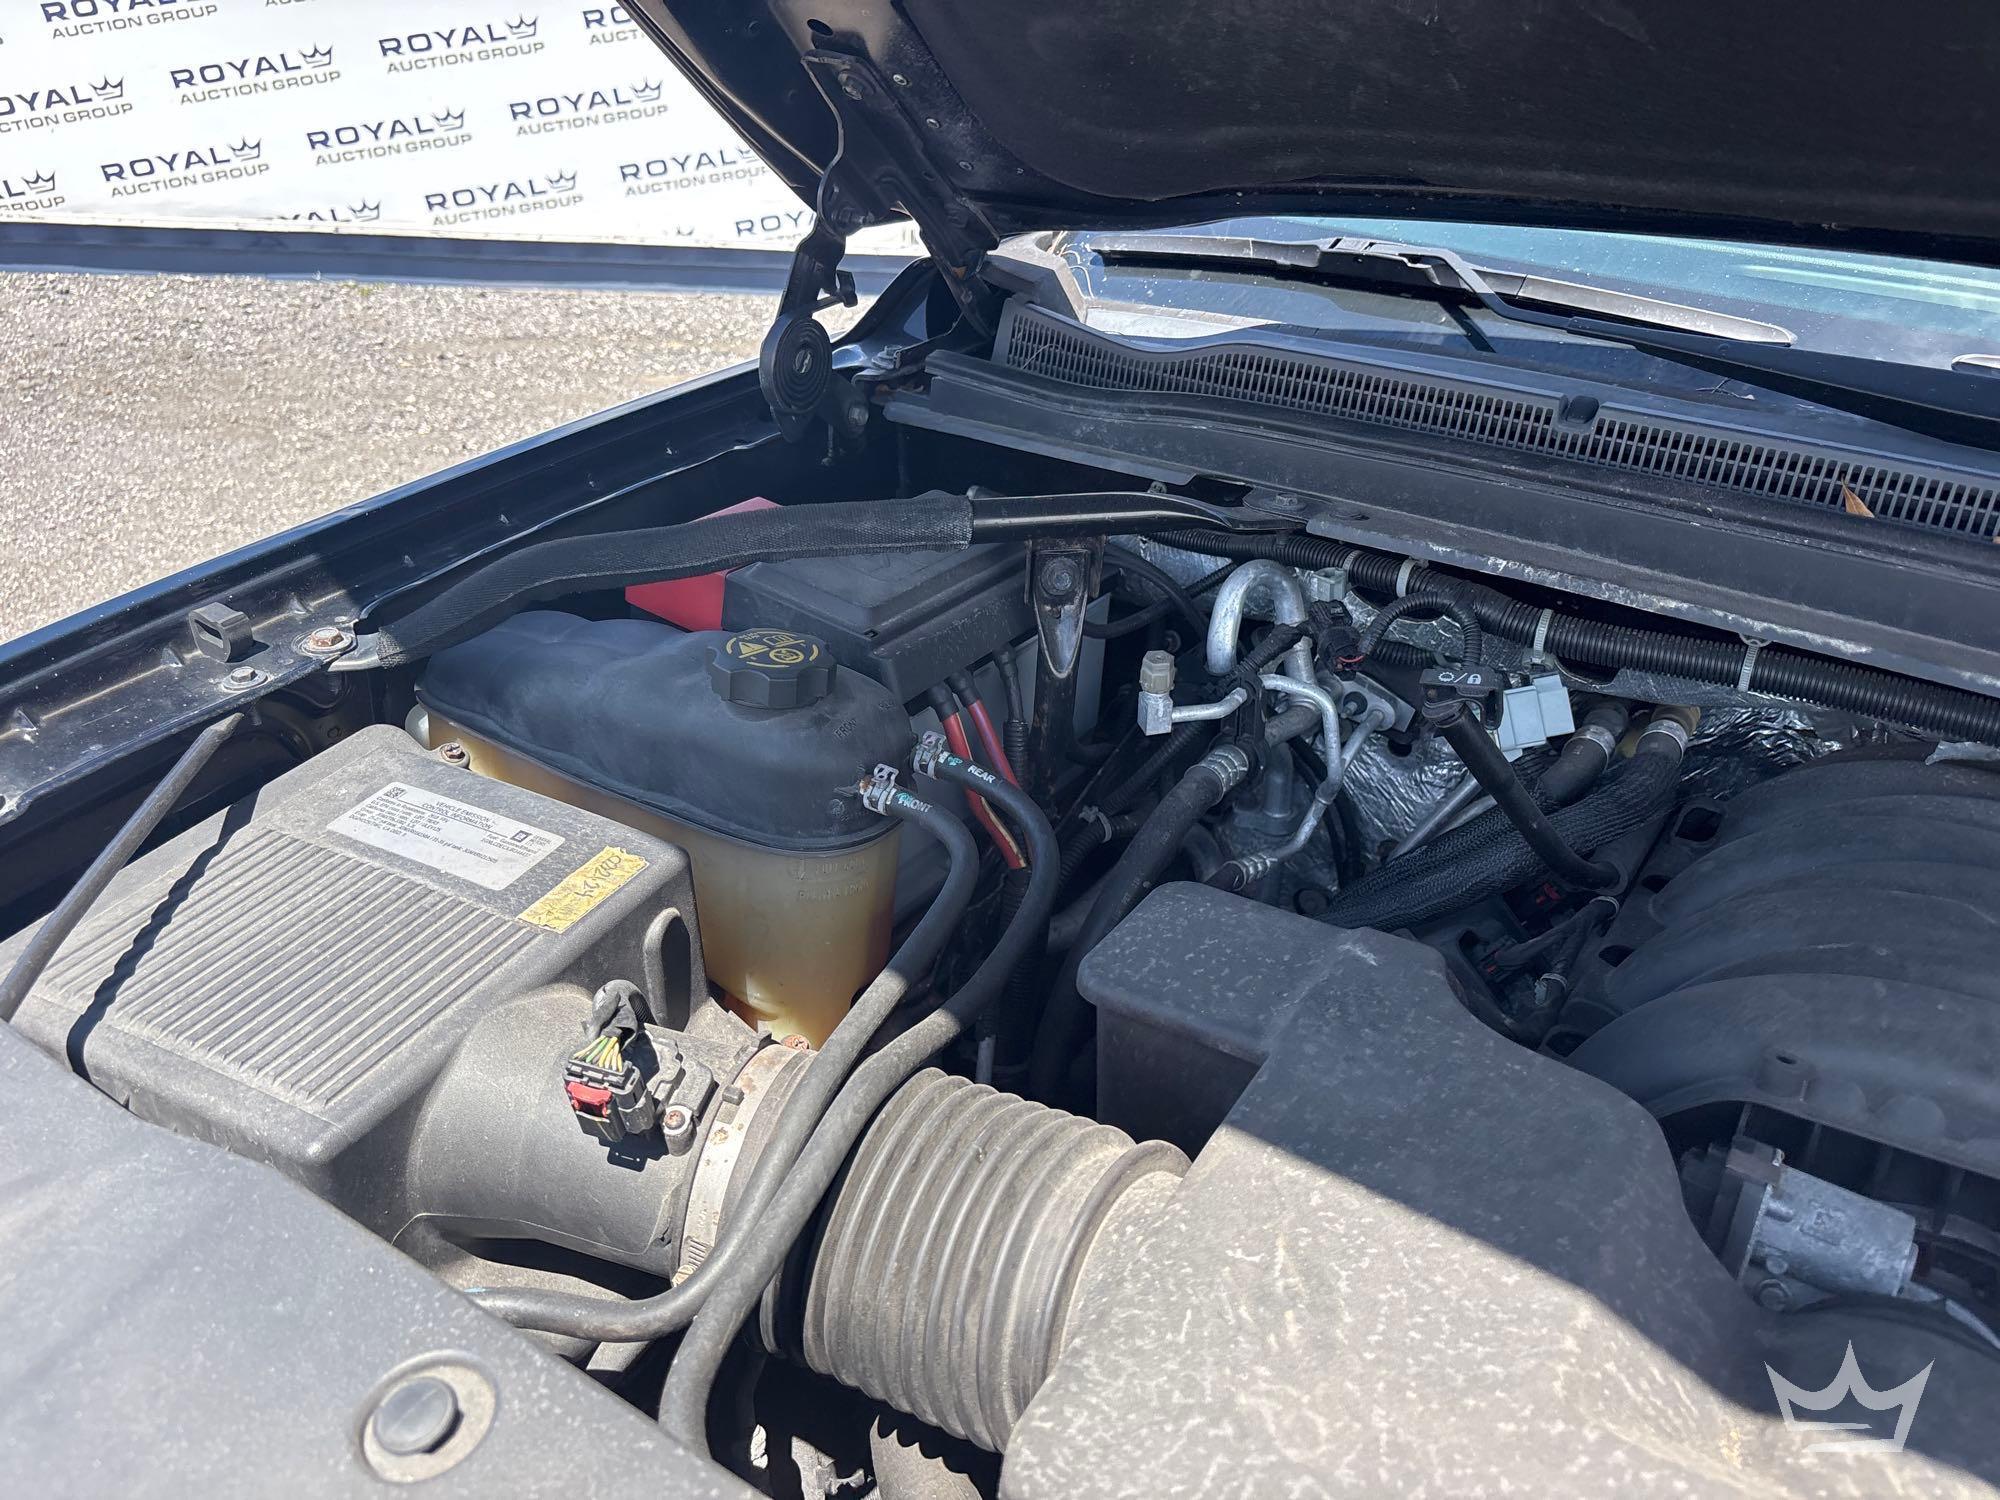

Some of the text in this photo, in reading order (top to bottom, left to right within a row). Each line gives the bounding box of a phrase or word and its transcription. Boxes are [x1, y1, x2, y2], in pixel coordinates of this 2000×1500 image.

[40, 0, 177, 22] ROY
[52, 4, 218, 39] AUCTION GROUP
[378, 24, 508, 57] ROYAL
[590, 29, 638, 45] AUCT
[170, 53, 301, 89] ROYAL
[386, 41, 545, 74] AUCTION GROUP
[0, 86, 93, 116] OYAL
[180, 70, 342, 105] AUCTION GROUP
[509, 88, 632, 120] ROYAL
[0, 102, 133, 133] CTION GROUP
[306, 117, 434, 150] ROYAL
[516, 104, 669, 136] AUCTION GROUP
[100, 147, 231, 182] ROYAL
[315, 133, 473, 166] AUCTION GROUP
[620, 149, 737, 182] ROYAL
[111, 163, 270, 198] AUCTION GROUP
[425, 179, 547, 212] ROYAL
[625, 175, 706, 197] AUCTION
[0, 196, 65, 211] ROUP
[433, 193, 584, 226] AUCTION GROUP
[735, 210, 815, 237] ROY
[967, 764, 997, 784] REAR
[897, 794, 933, 813] FRONT
